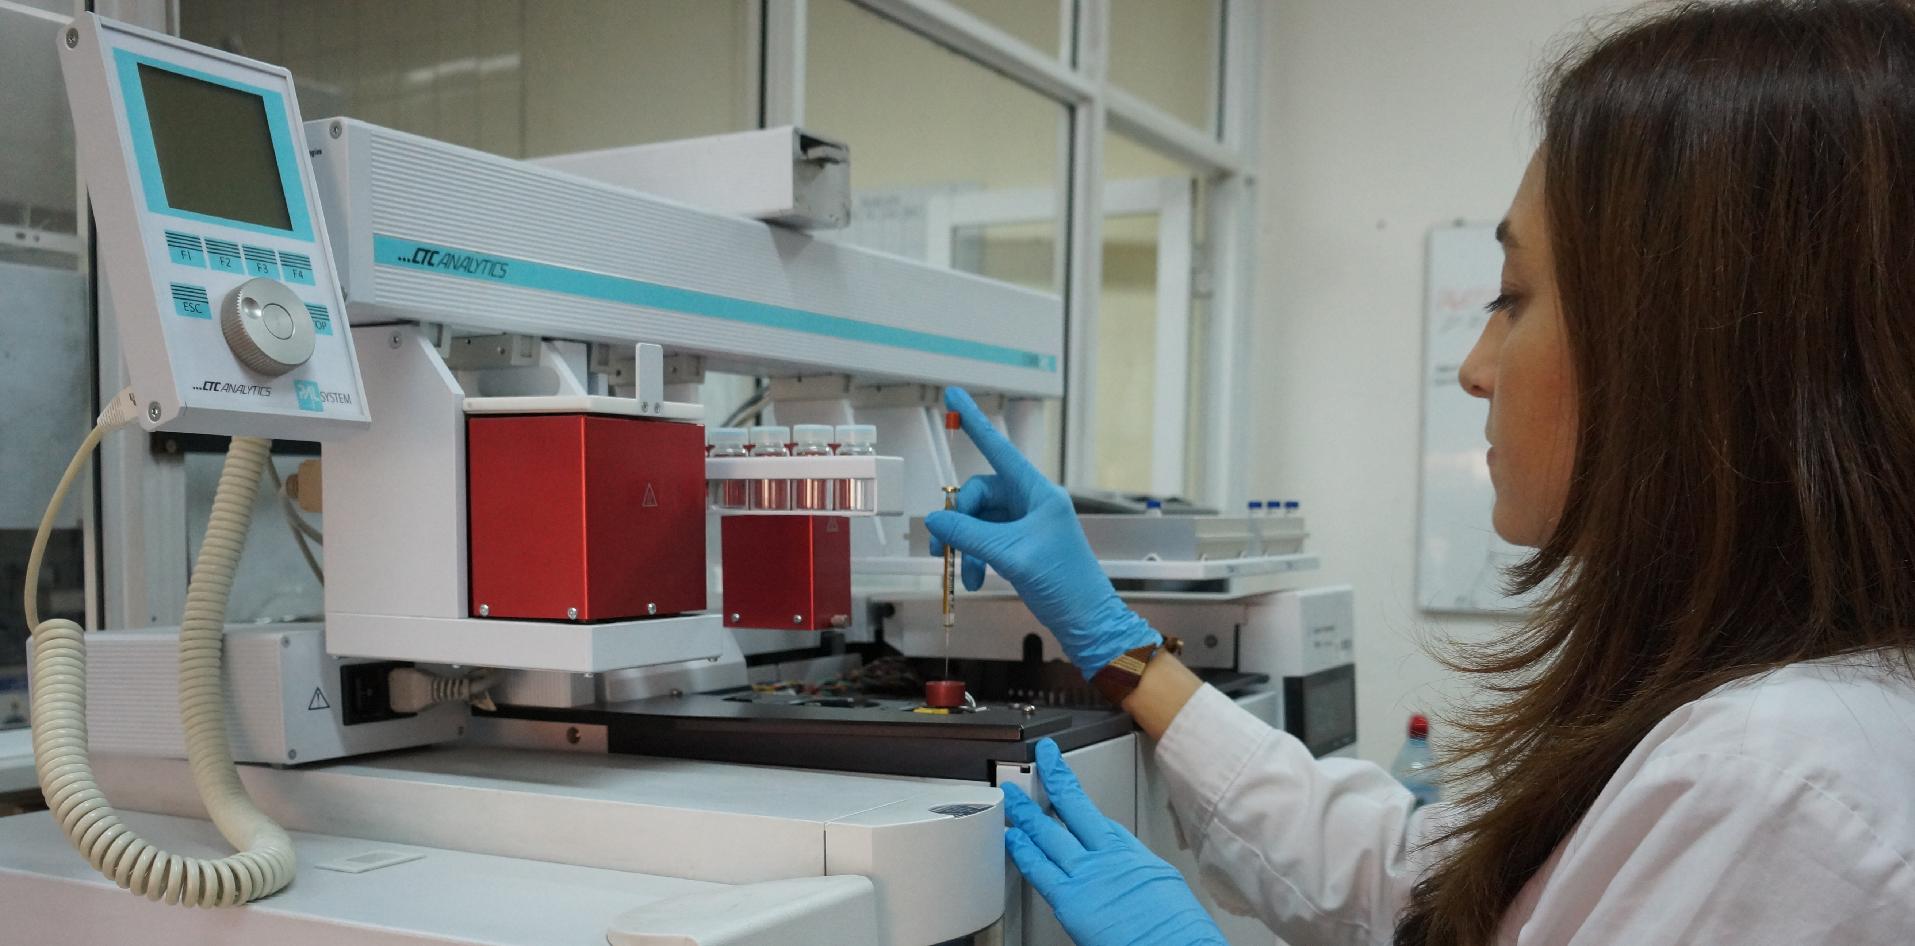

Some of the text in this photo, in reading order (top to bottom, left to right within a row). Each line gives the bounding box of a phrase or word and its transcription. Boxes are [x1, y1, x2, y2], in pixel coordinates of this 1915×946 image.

[181, 251, 192, 261] F1
[219, 256, 232, 268] F2
[437, 253, 508, 278] ANALYTICS
[256, 264, 269, 274] F3
[293, 269, 304, 279] F4
[183, 302, 203, 313] ESC
[220, 383, 271, 397] ANALYTICS
[319, 391, 352, 405] SYSTEM
